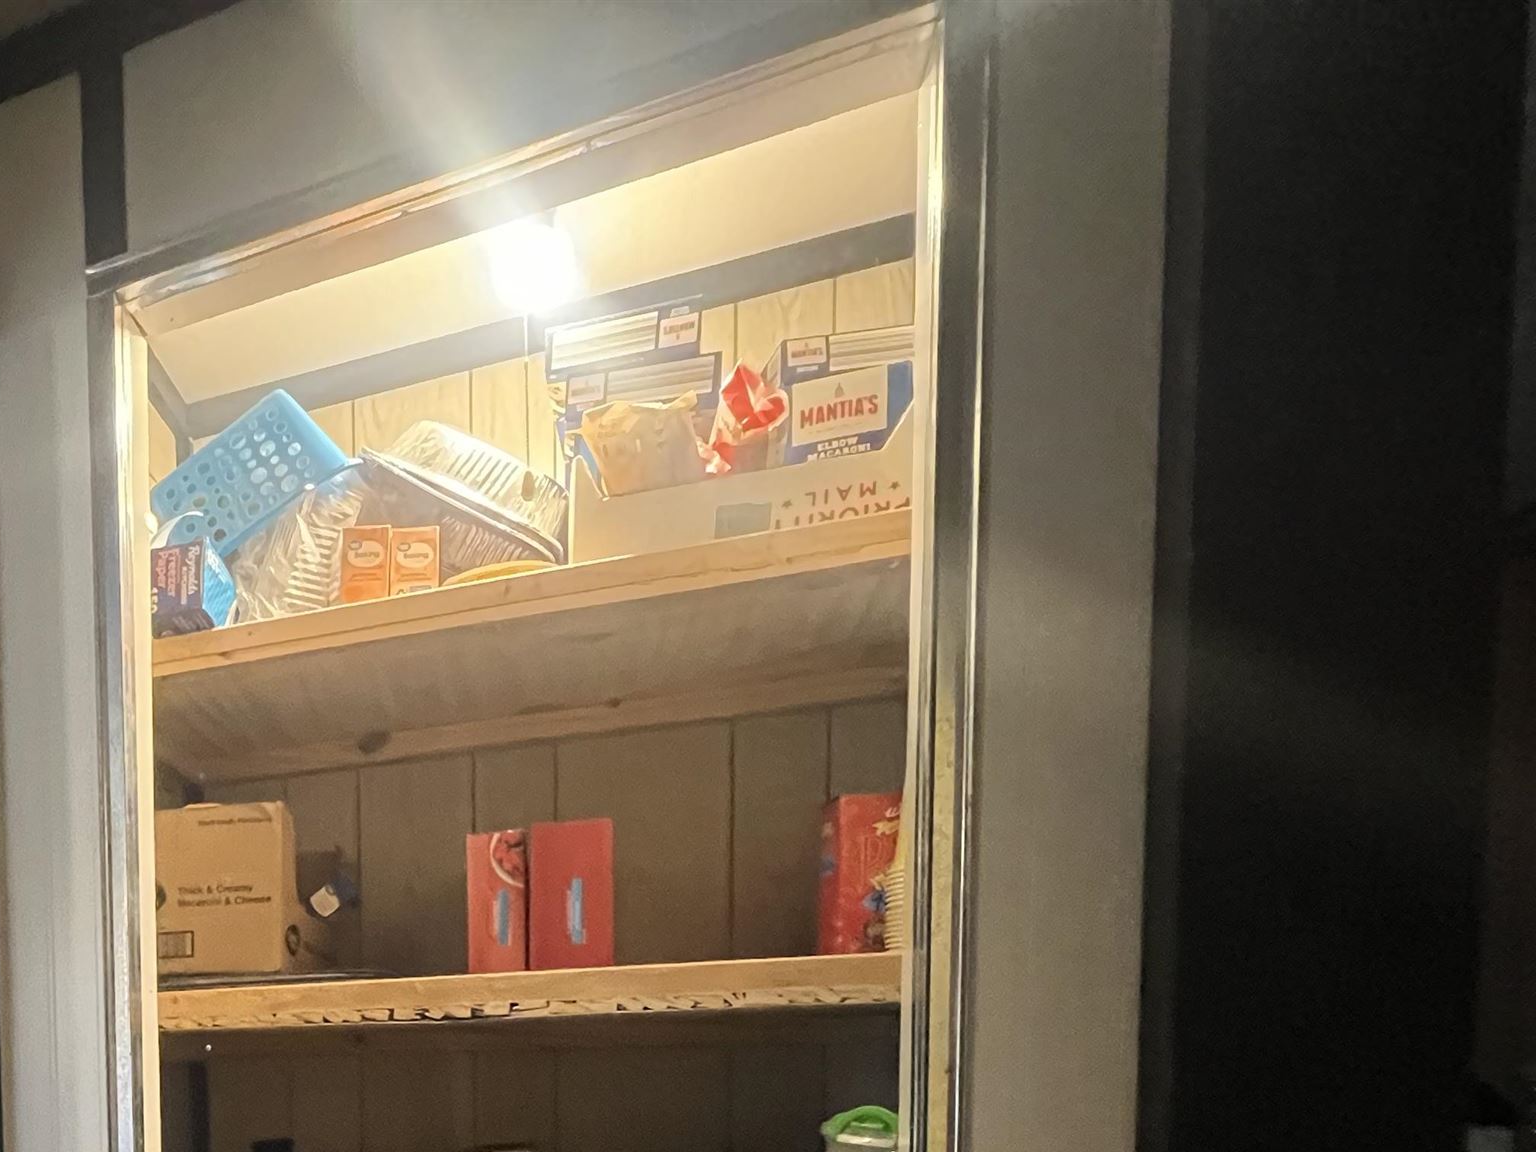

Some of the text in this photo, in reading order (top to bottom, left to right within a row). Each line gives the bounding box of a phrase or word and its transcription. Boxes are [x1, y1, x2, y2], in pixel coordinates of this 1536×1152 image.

[800, 394, 879, 429] MANTIA'S
[817, 436, 858, 451] ELBOW
[805, 480, 877, 506] MAIL
[156, 551, 168, 588] Paper
[185, 544, 200, 595] Reynolds
